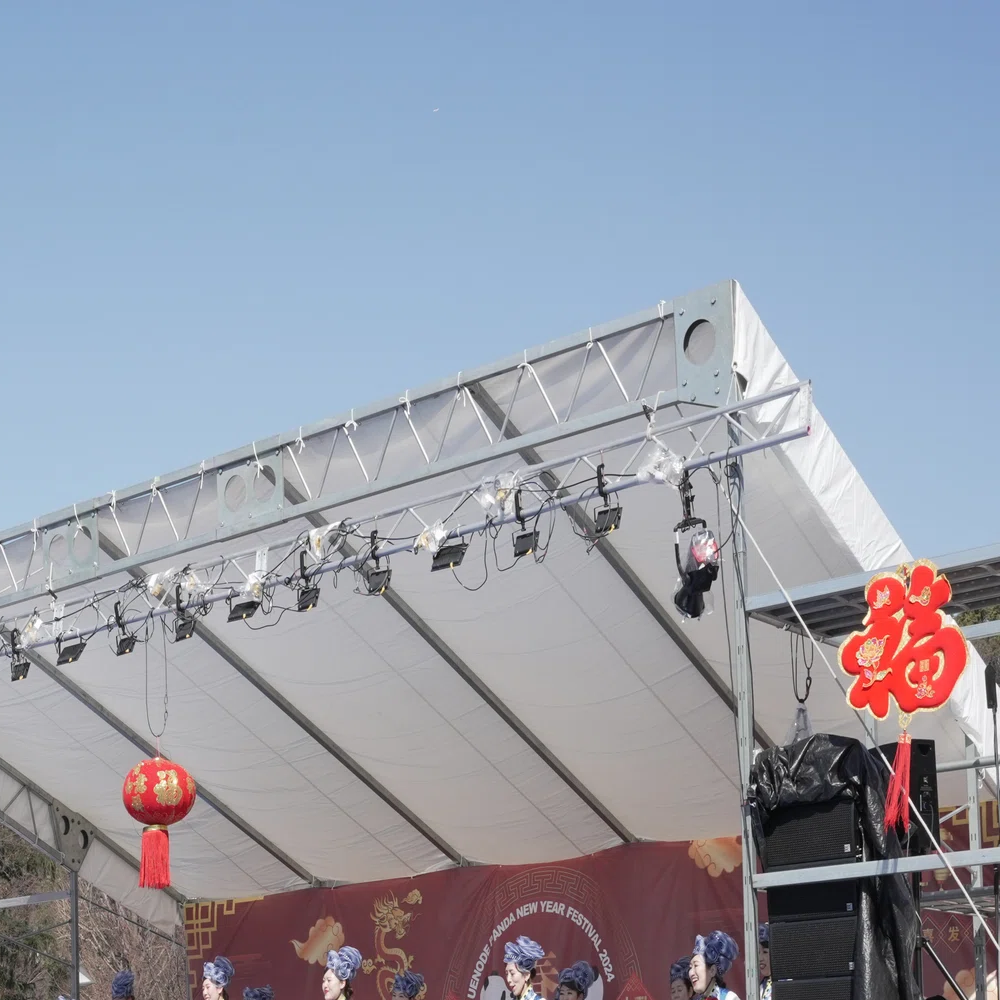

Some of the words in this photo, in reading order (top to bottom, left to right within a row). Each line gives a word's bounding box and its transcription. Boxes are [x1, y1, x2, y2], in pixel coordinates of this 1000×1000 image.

[467, 944, 490, 999] UENODE
[516, 901, 538, 919] NEW
[540, 901, 565, 916] YEAR
[566, 906, 601, 951] FESTIVAL
[599, 949, 615, 982] 2024
